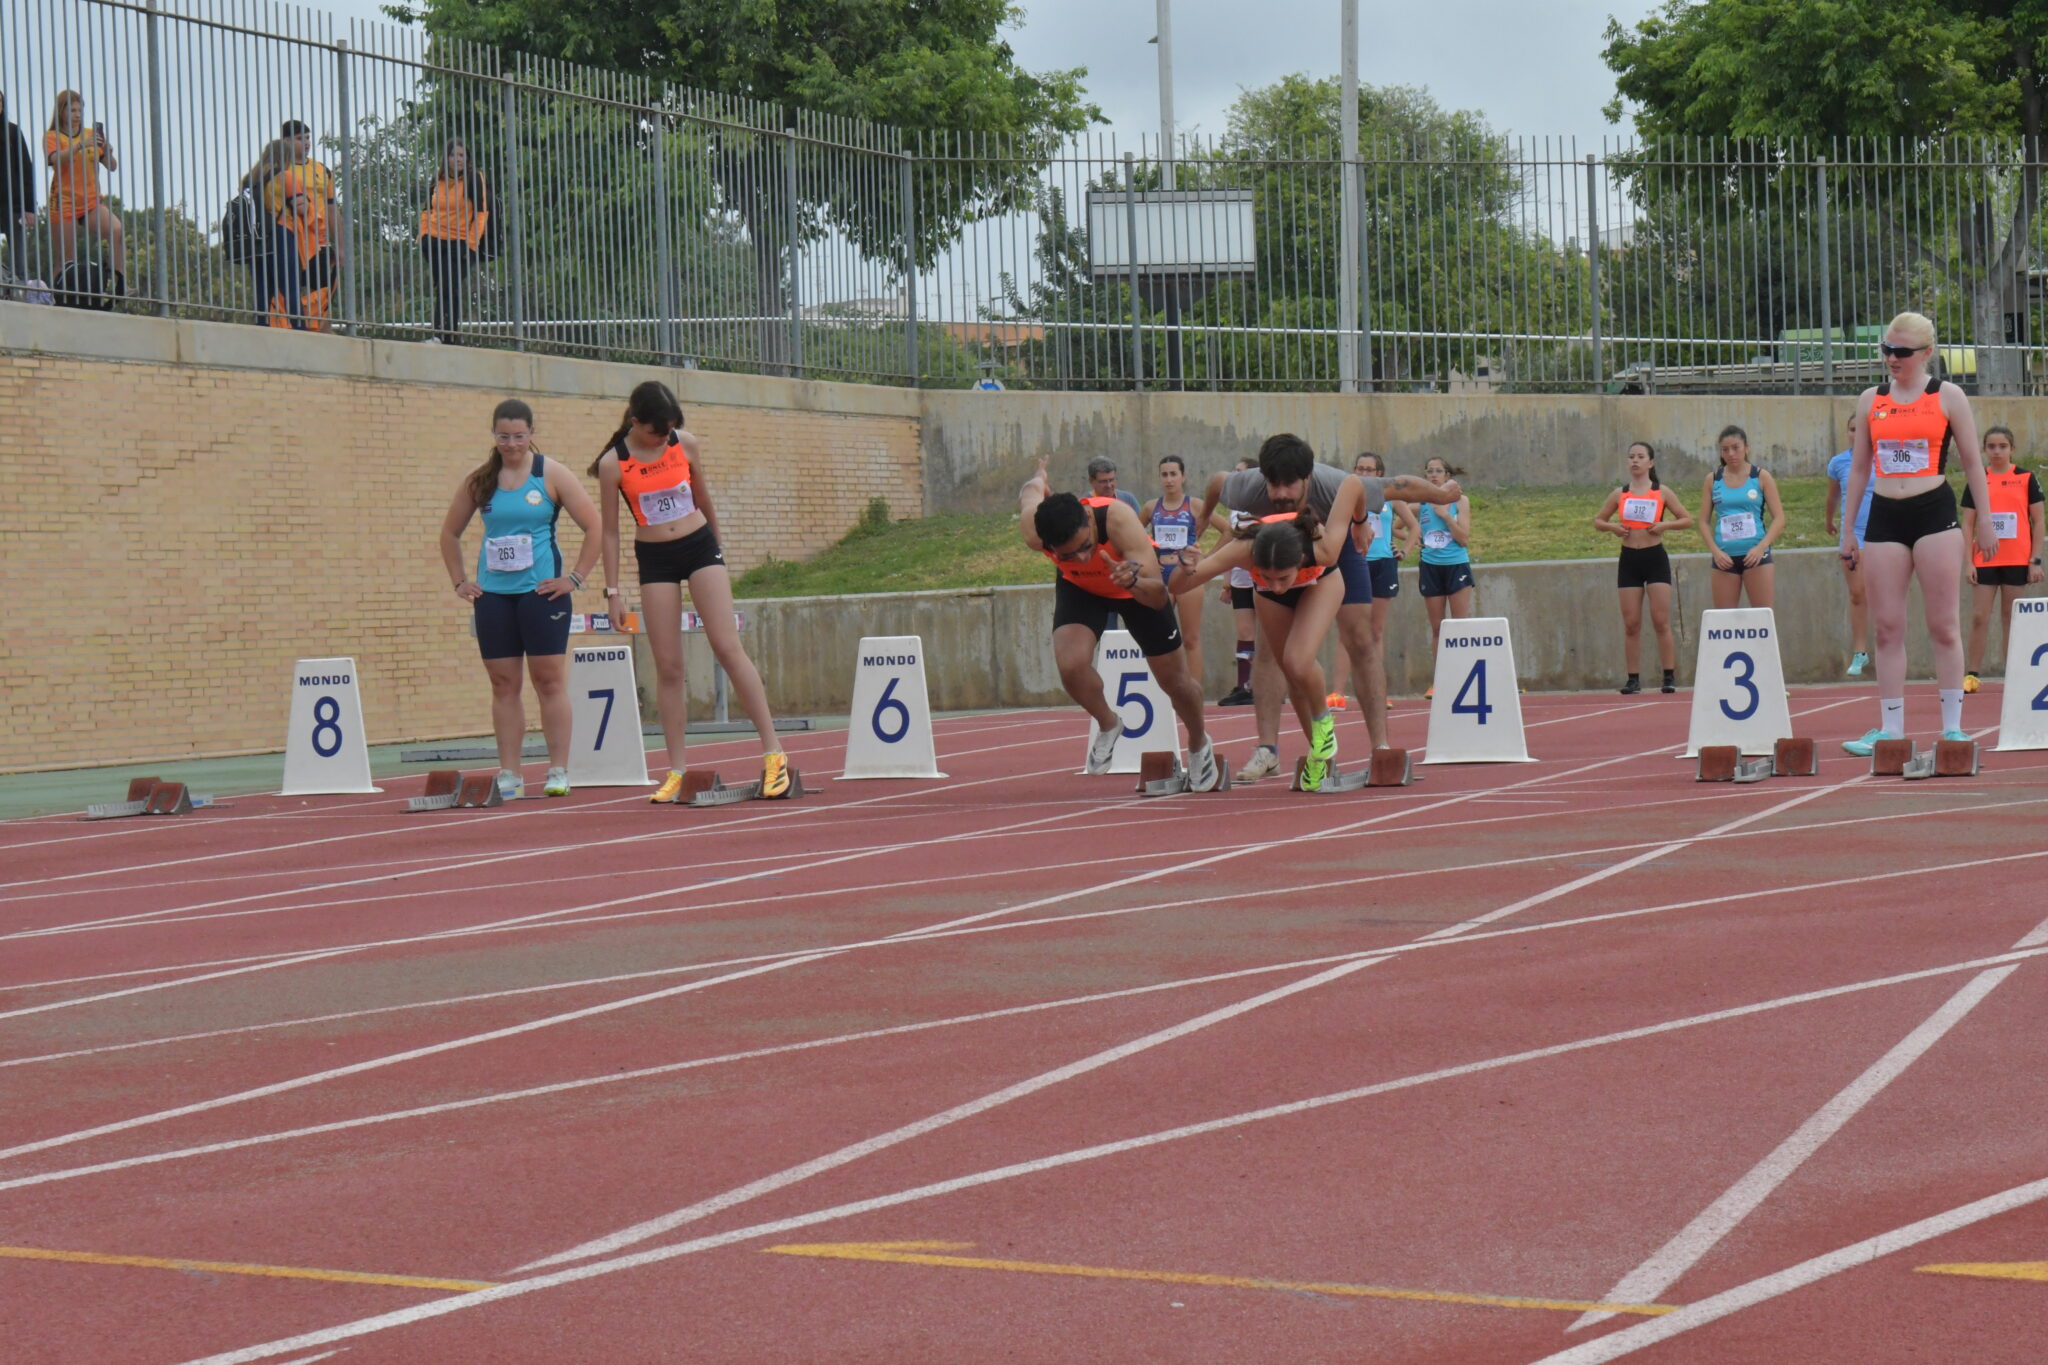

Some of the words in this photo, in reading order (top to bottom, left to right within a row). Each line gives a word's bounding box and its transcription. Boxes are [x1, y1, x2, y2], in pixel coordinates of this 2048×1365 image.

[1892, 449, 1911, 463] 306
[657, 497, 676, 512] 291
[1633, 505, 1647, 515] 312
[1730, 521, 1744, 532] 252
[1164, 532, 1177, 542] 203
[1433, 535, 1445, 543] 235
[498, 547, 515, 561] 263
[2018, 602, 2048, 614] MO
[1708, 627, 1769, 640] MONDO
[1445, 635, 1503, 649] MONDO
[575, 651, 626, 663] MONDO
[863, 655, 916, 667] MONDO
[1106, 649, 1145, 660] MON
[299, 675, 351, 686] MONDO
[2030, 642, 2048, 711] 2
[1451, 659, 1493, 725] 4
[1719, 651, 1760, 721] 3
[871, 677, 910, 744] 6
[1115, 672, 1154, 739] 5
[311, 695, 343, 758] 8
[587, 688, 615, 752] 7
